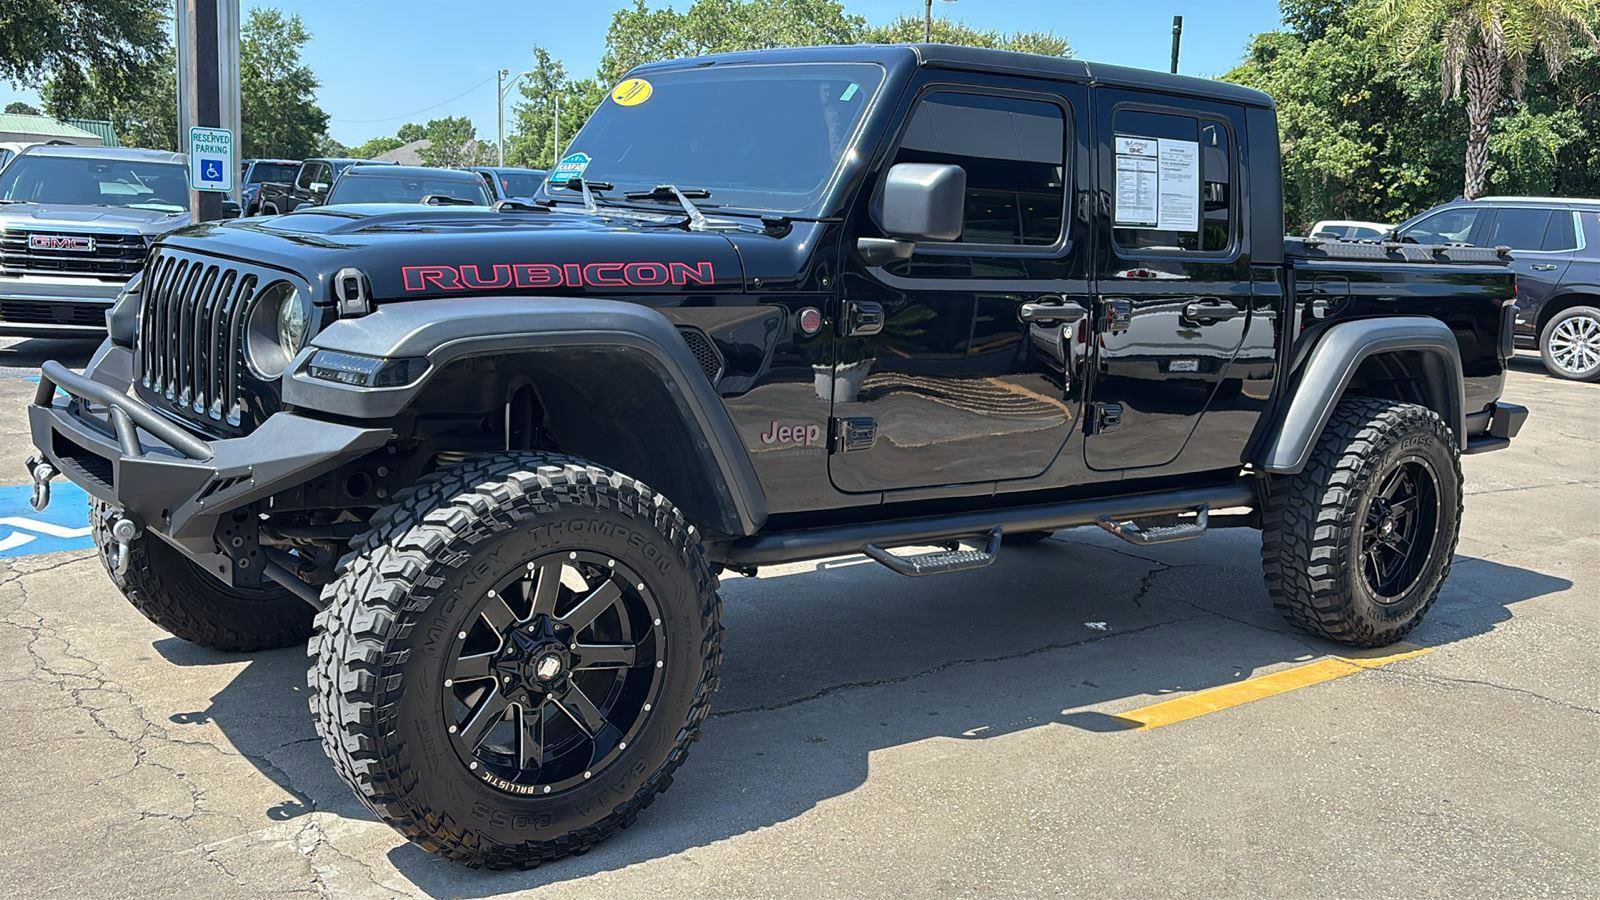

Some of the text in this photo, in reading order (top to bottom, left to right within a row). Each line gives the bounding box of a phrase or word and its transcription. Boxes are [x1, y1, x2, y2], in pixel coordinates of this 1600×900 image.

[192, 132, 230, 144] RESERVED
[195, 144, 228, 154] PARKING
[33, 236, 89, 250] GMC
[402, 262, 714, 291] RUBICON
[761, 420, 820, 446] Jeep
[528, 518, 672, 576] THOMPSON
[481, 771, 535, 795] BALLISTIC
